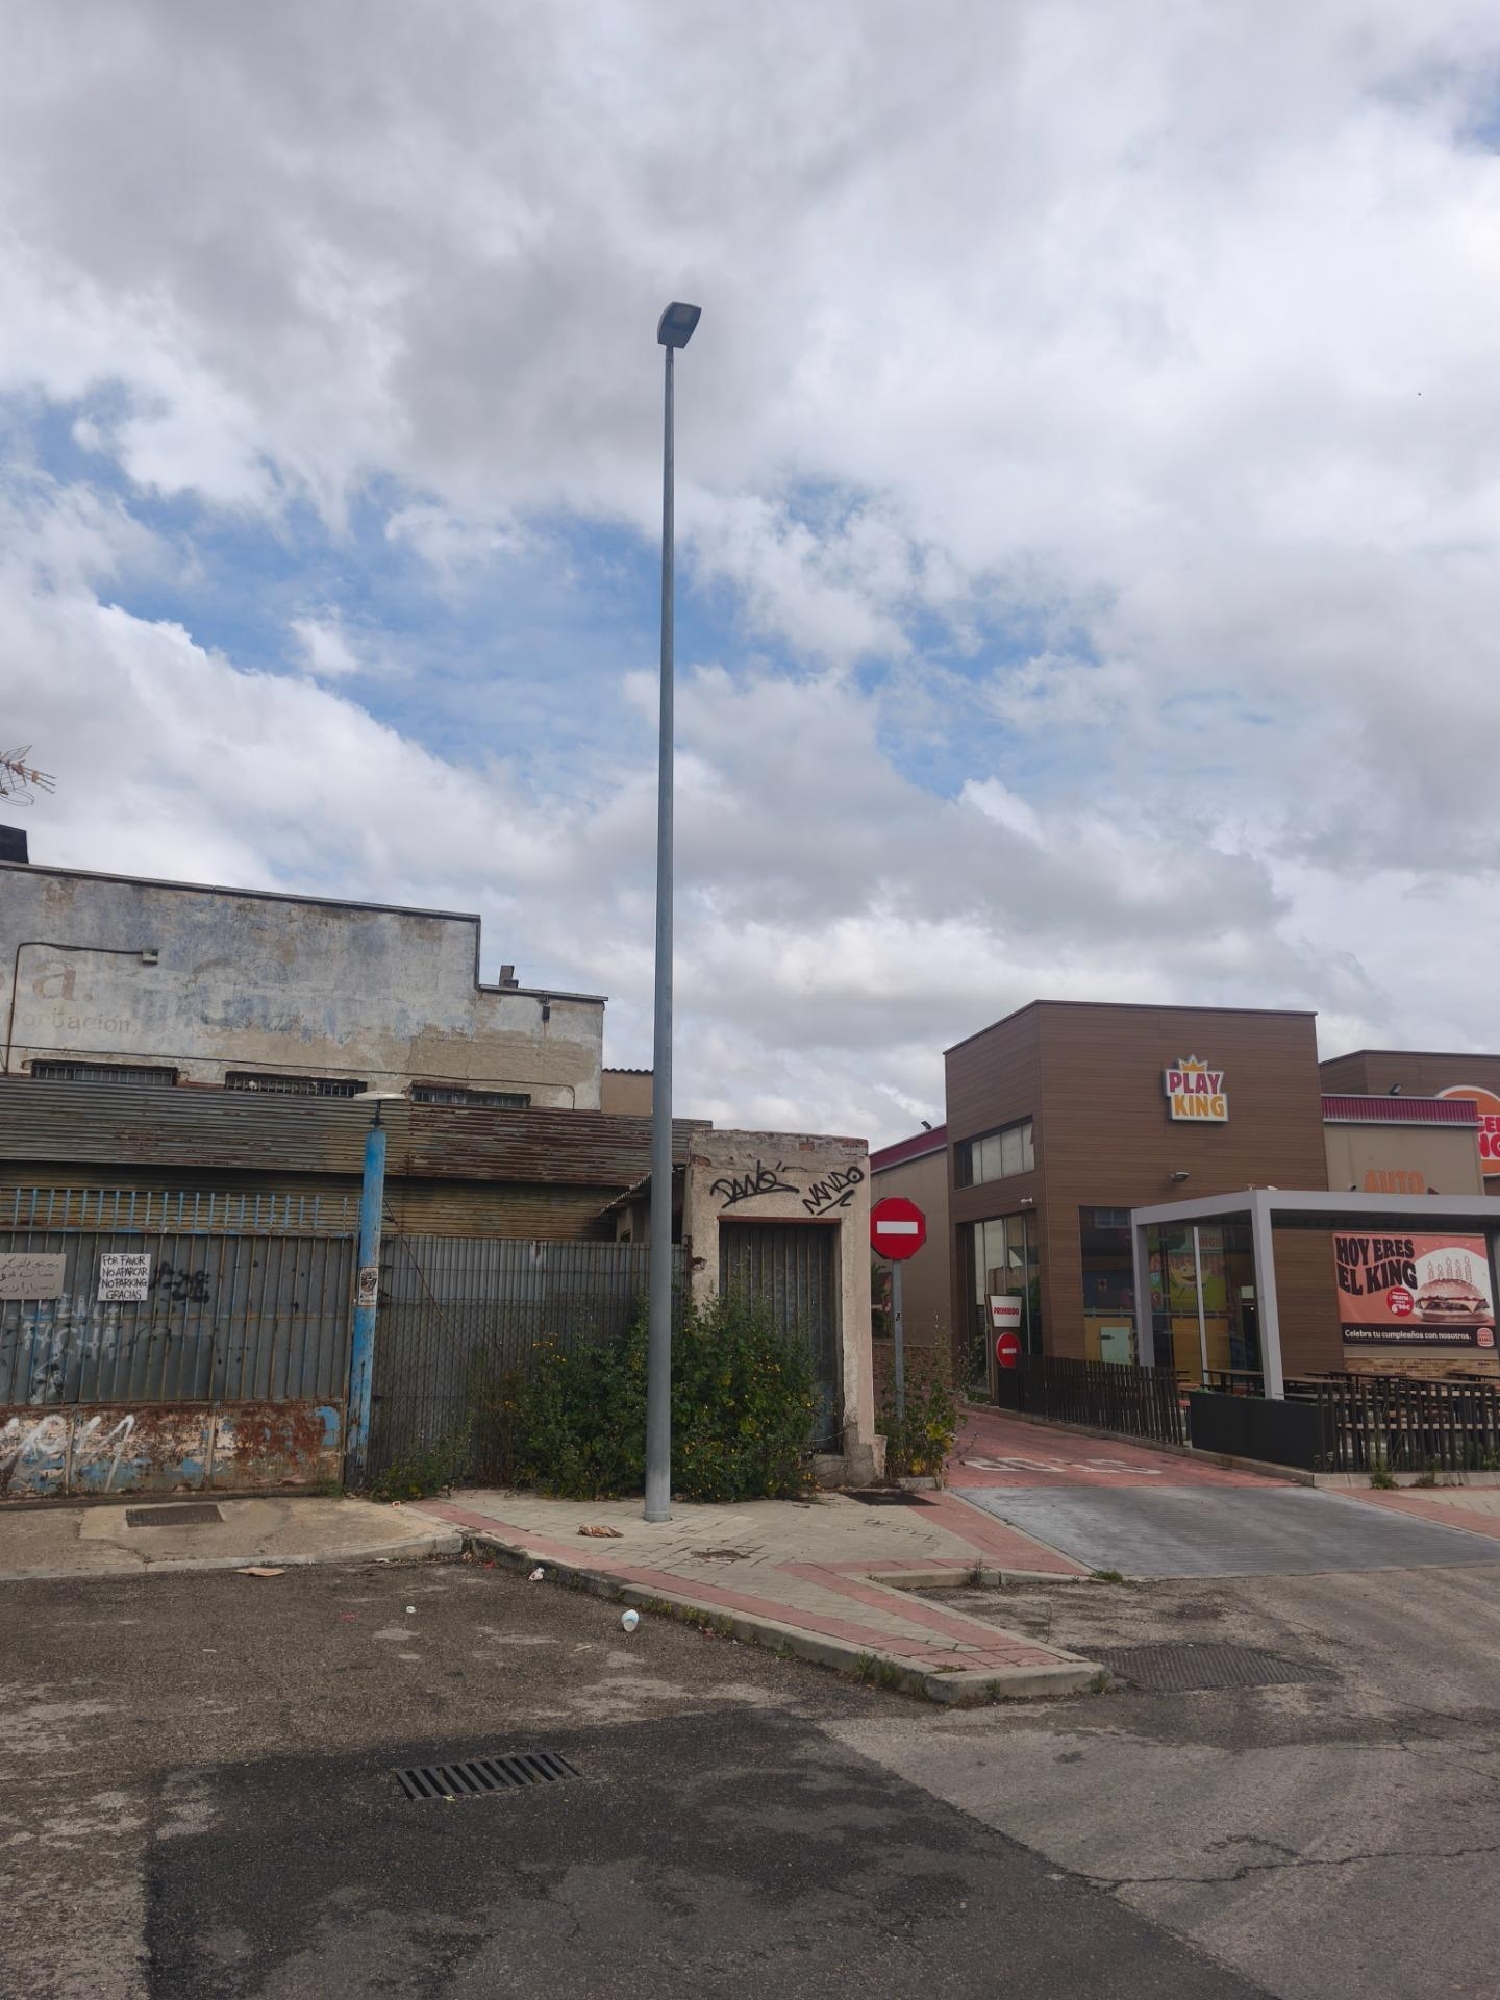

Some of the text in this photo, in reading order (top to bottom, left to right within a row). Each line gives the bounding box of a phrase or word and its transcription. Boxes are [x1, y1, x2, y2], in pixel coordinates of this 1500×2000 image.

[1169, 1072, 1220, 1095] PLAY
[1174, 1094, 1225, 1118] KING
[1365, 1168, 1425, 1195] AUTO
[102, 1255, 146, 1266] POR FAVOR
[1334, 1238, 1415, 1267] HOY ERES
[102, 1267, 149, 1277] NO APARCAR
[1338, 1258, 1418, 1296] EL KING
[101, 1277, 148, 1289] NO PARKING
[105, 1289, 142, 1300] GRACIAS
[1345, 1329, 1371, 1338] Celebra
[1381, 1331, 1424, 1341] cumpleaños
